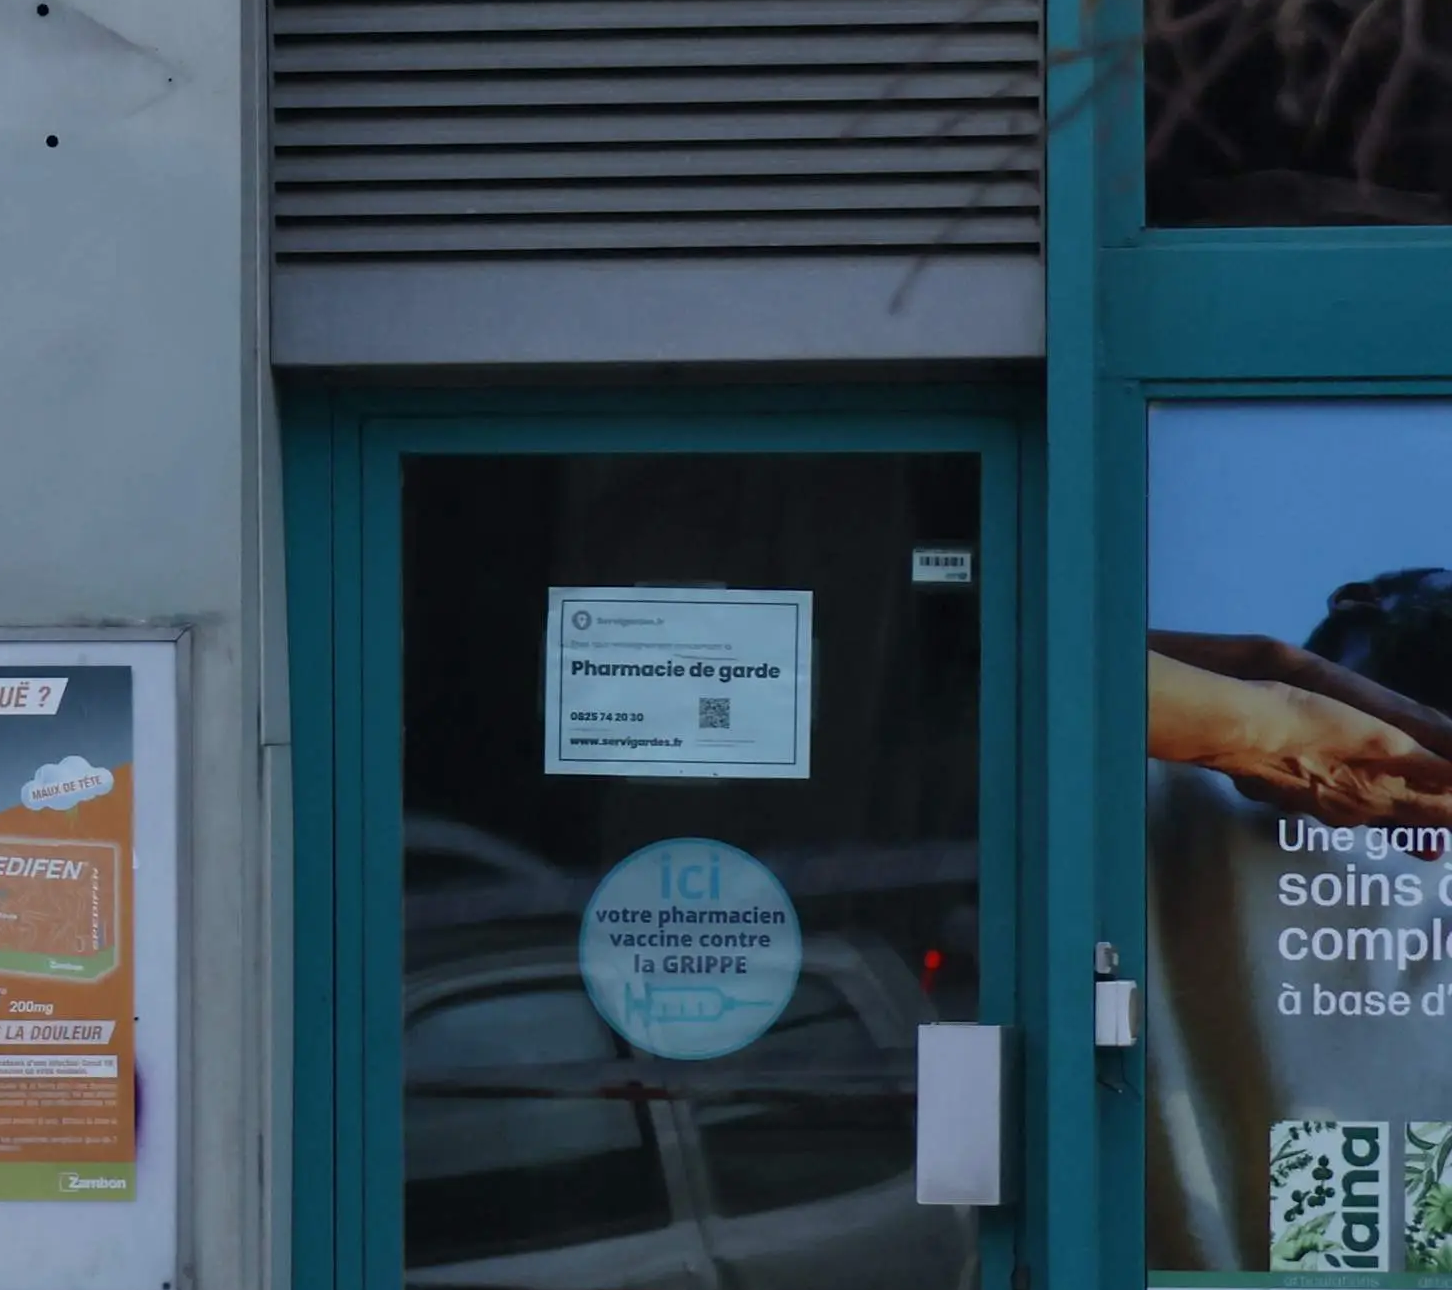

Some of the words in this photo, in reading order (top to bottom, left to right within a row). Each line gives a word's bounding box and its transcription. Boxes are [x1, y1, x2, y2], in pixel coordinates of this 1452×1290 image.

[571, 659, 686, 678] Pharmacie
[689, 661, 716, 678] de
[718, 662, 781, 684] garde
[38, 685, 52, 708] ?
[570, 711, 598, 722] 0825
[600, 712, 613, 722] 74
[615, 712, 628, 722] 20
[31, 782, 61, 801] MAUX
[62, 780, 77, 794] DE
[78, 774, 103, 791] TÊTE
[1278, 818, 1355, 852] Une
[1365, 826, 1452, 861] gam
[660, 850, 722, 901] ici
[1278, 863, 1424, 907] soins
[595, 907, 653, 924] votre
[658, 905, 786, 929] pharmacien
[609, 929, 693, 948] vaccine
[698, 931, 771, 949] contre
[1278, 917, 1452, 971] compl
[633, 953, 655, 974] la
[662, 955, 748, 975] GRIPPE
[9, 1000, 54, 1015] 200mg
[1277, 982, 1302, 1016] à
[1313, 982, 1412, 1016] base
[4, 1025, 25, 1040] LA
[30, 1025, 103, 1041] DOULEUR
[68, 1173, 127, 1191] Zambon
